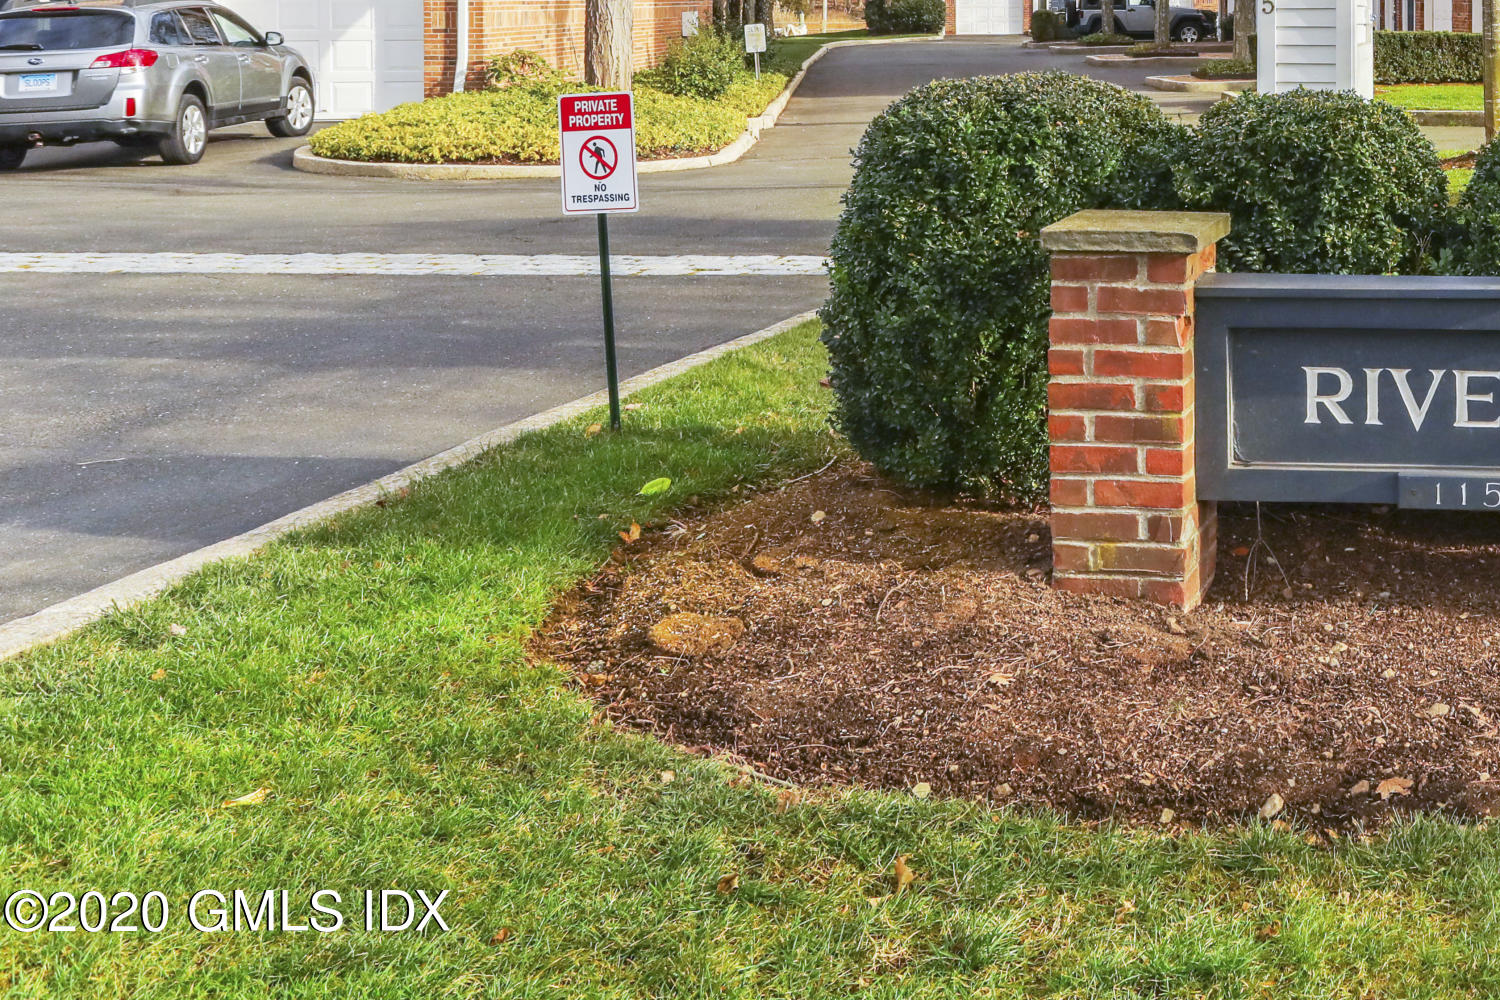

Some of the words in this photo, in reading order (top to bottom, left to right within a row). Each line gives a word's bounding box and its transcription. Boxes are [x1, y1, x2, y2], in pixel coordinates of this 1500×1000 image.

[574, 99, 618, 113] PRIVATE
[568, 113, 624, 127] PROPERTY
[594, 184, 607, 192] NO
[572, 193, 630, 204] TRESPASSING
